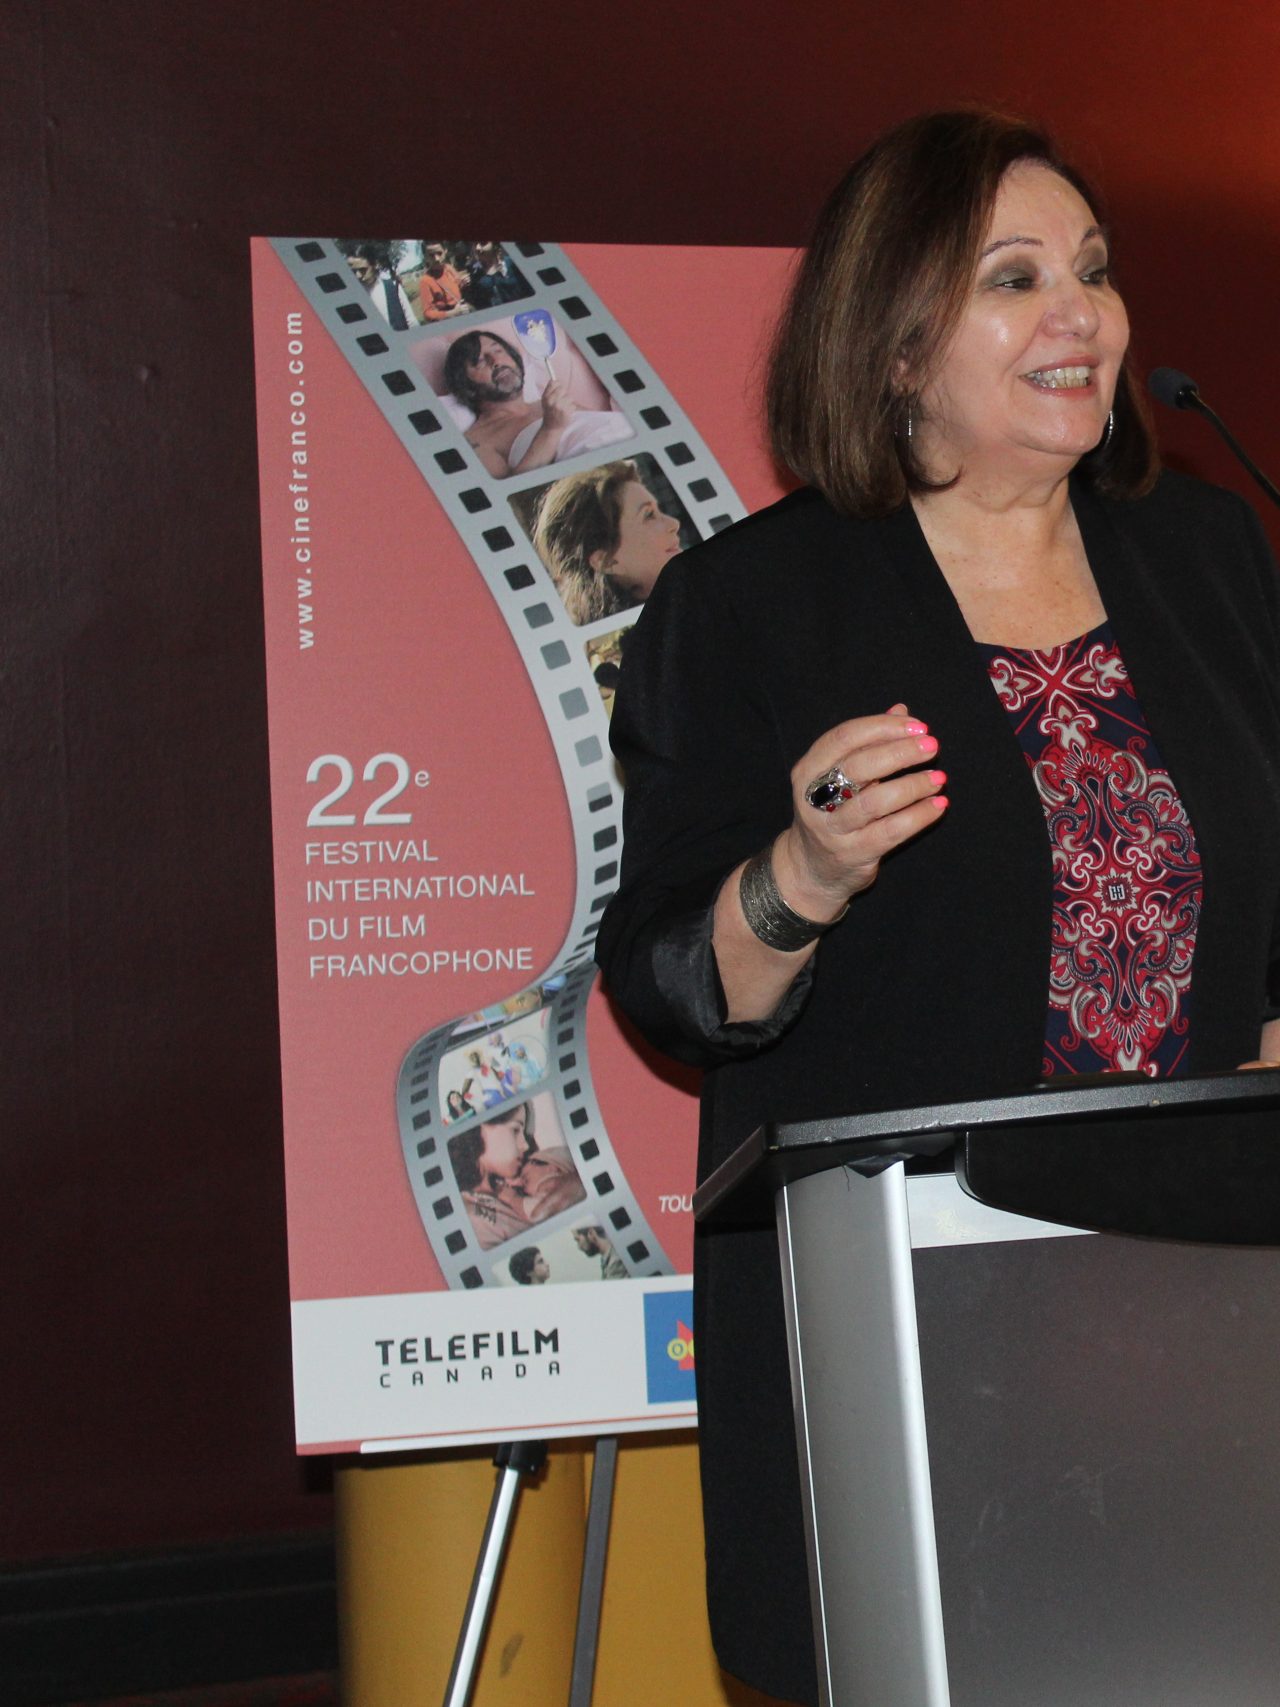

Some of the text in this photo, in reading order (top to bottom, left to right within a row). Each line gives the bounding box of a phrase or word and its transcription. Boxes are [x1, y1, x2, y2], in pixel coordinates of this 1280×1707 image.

[287, 311, 314, 650] www.cinefranco.com
[305, 839, 438, 865] FESTIVAL
[306, 873, 535, 902] INTERNATIONAL
[308, 914, 426, 941] DU FILM
[309, 948, 534, 978] FRANCOPHONE
[375, 1328, 559, 1367] TELEFILM
[380, 1361, 560, 1388] CANADA
